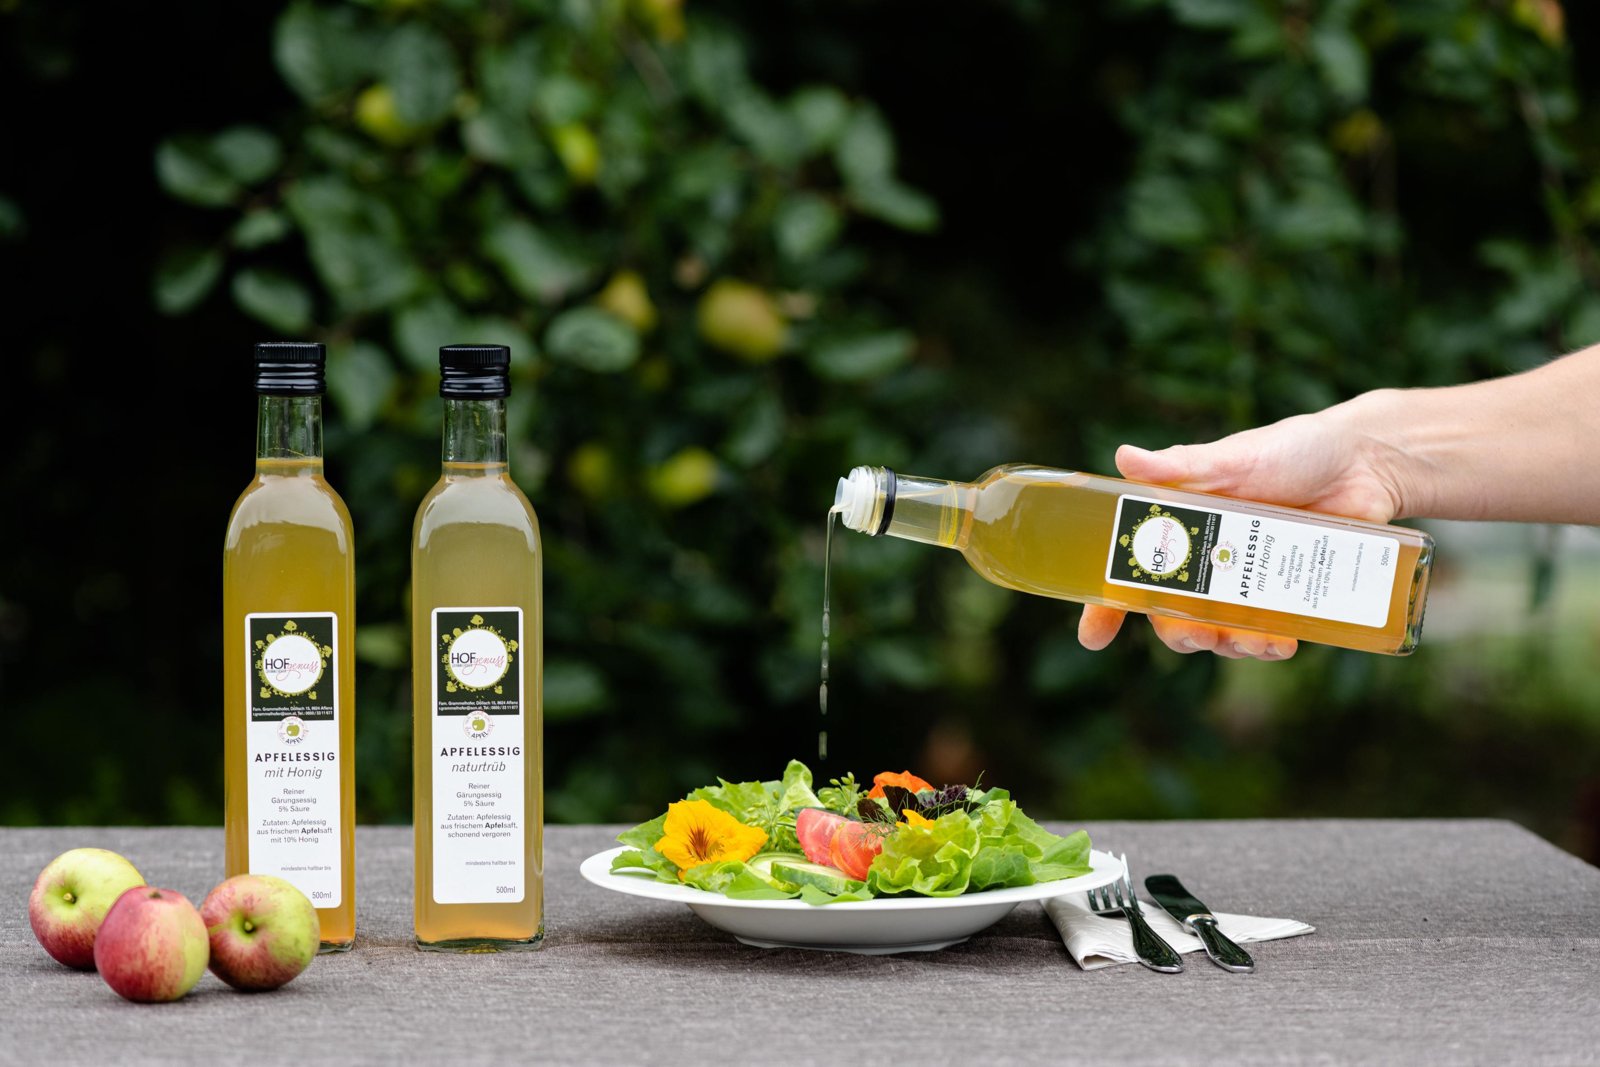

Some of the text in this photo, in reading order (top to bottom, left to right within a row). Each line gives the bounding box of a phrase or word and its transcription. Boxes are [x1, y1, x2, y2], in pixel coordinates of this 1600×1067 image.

[1240, 520, 1260, 598] APFELESSIG
[1257, 535, 1275, 591] mit Honig
[1278, 555, 1287, 576] Reiner
[1313, 567, 1323, 595] frischem
[1319, 536, 1328, 566] Apfelsaft
[1326, 550, 1336, 570] Honig
[1381, 547, 1390, 566] 500ml
[1294, 574, 1300, 583] 5%
[1304, 540, 1321, 602] Zutaten: Apfelessig
[255, 752, 335, 762] APFELESSIG
[440, 747, 520, 757] APFELESSIG
[264, 767, 322, 779] mit Honig
[452, 762, 506, 772] naturtrüb
